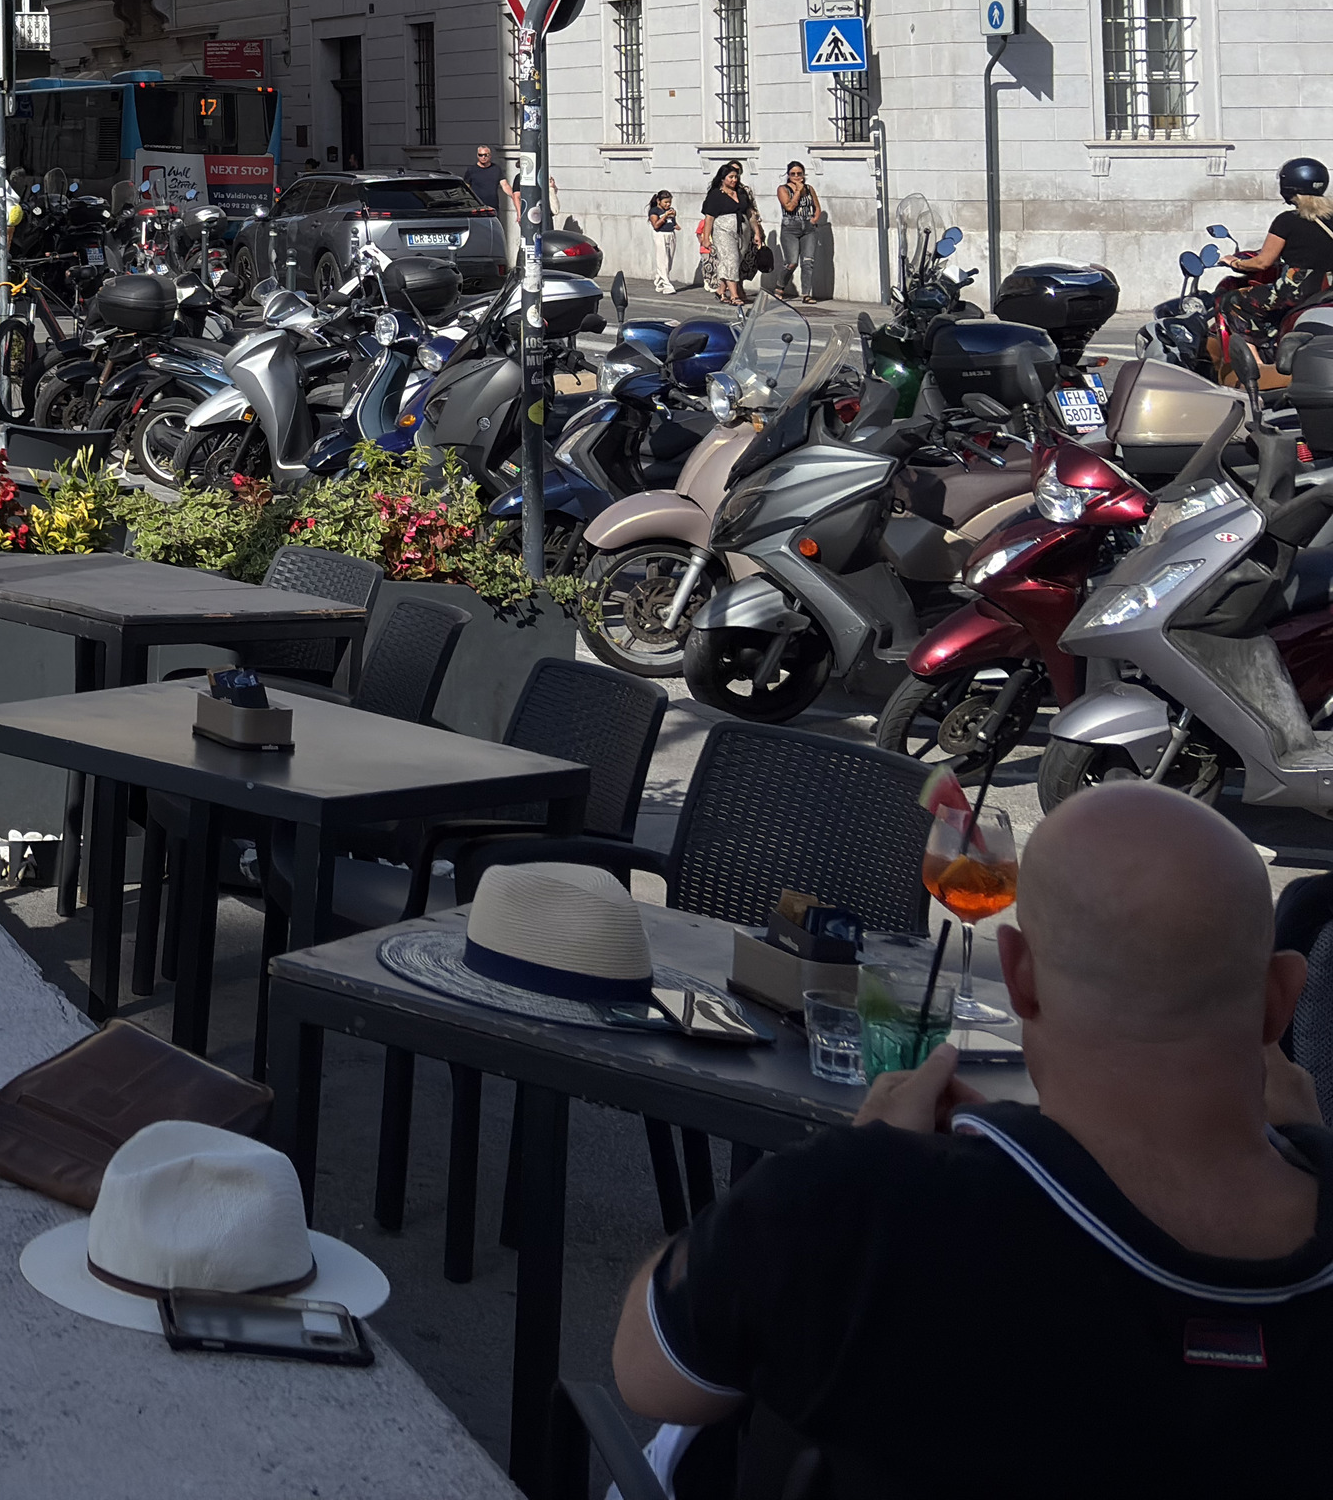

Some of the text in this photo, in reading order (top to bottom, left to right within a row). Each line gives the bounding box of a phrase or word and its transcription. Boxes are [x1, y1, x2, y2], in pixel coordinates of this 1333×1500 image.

[200, 98, 217, 116] 17
[209, 165, 269, 176] NEXT STOP
[229, 192, 257, 200] Valdirivo
[1065, 407, 1101, 422] 58073
